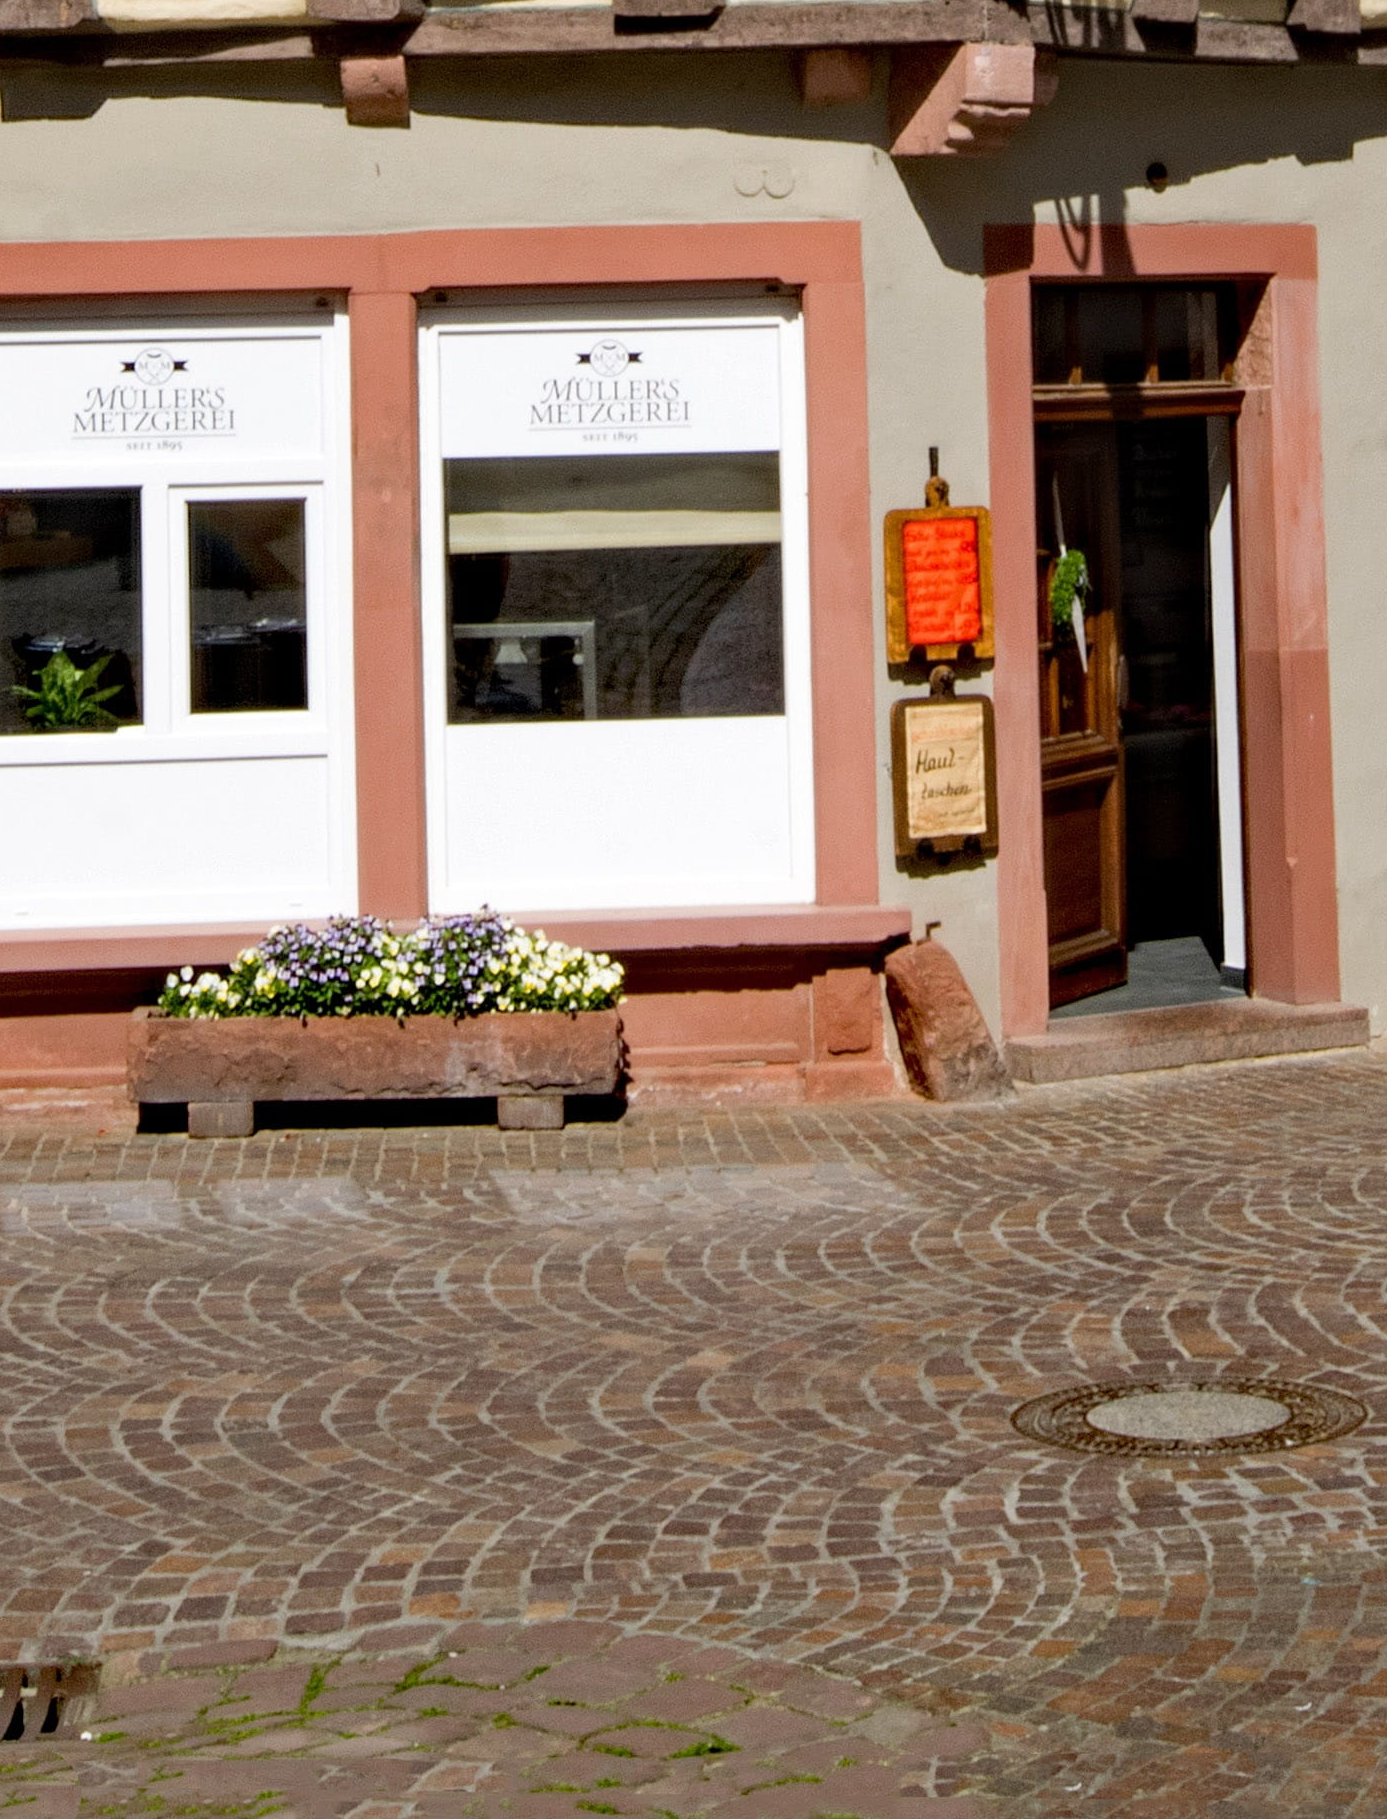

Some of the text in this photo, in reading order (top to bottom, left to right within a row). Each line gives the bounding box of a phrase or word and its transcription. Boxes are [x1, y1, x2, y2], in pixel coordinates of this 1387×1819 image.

[84, 385, 225, 412] MÜLLER'S
[541, 377, 680, 404] MÜLLER'S
[73, 410, 235, 433] METZGEREI
[530, 401, 690, 425] METZGEREI
[157, 440, 183, 451] 1895
[612, 432, 638, 442] 1895
